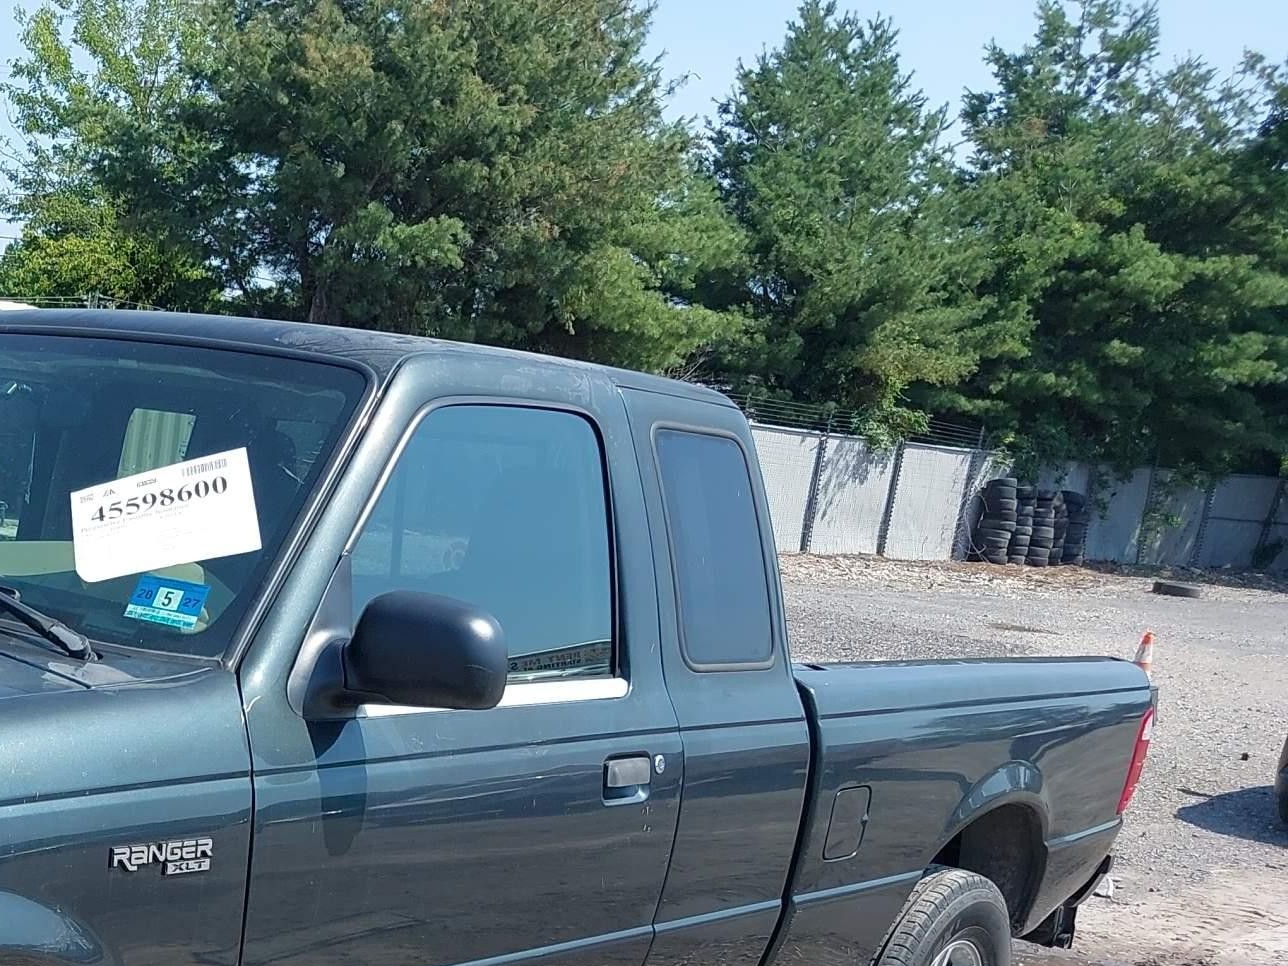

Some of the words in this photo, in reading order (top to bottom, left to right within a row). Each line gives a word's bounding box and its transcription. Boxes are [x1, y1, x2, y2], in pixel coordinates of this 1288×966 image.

[91, 476, 228, 521] 45598600
[136, 588, 153, 600] 20
[161, 591, 175, 607] 5
[182, 597, 202, 609] 27
[110, 839, 213, 872] RANGER
[169, 860, 207, 873] XLT
